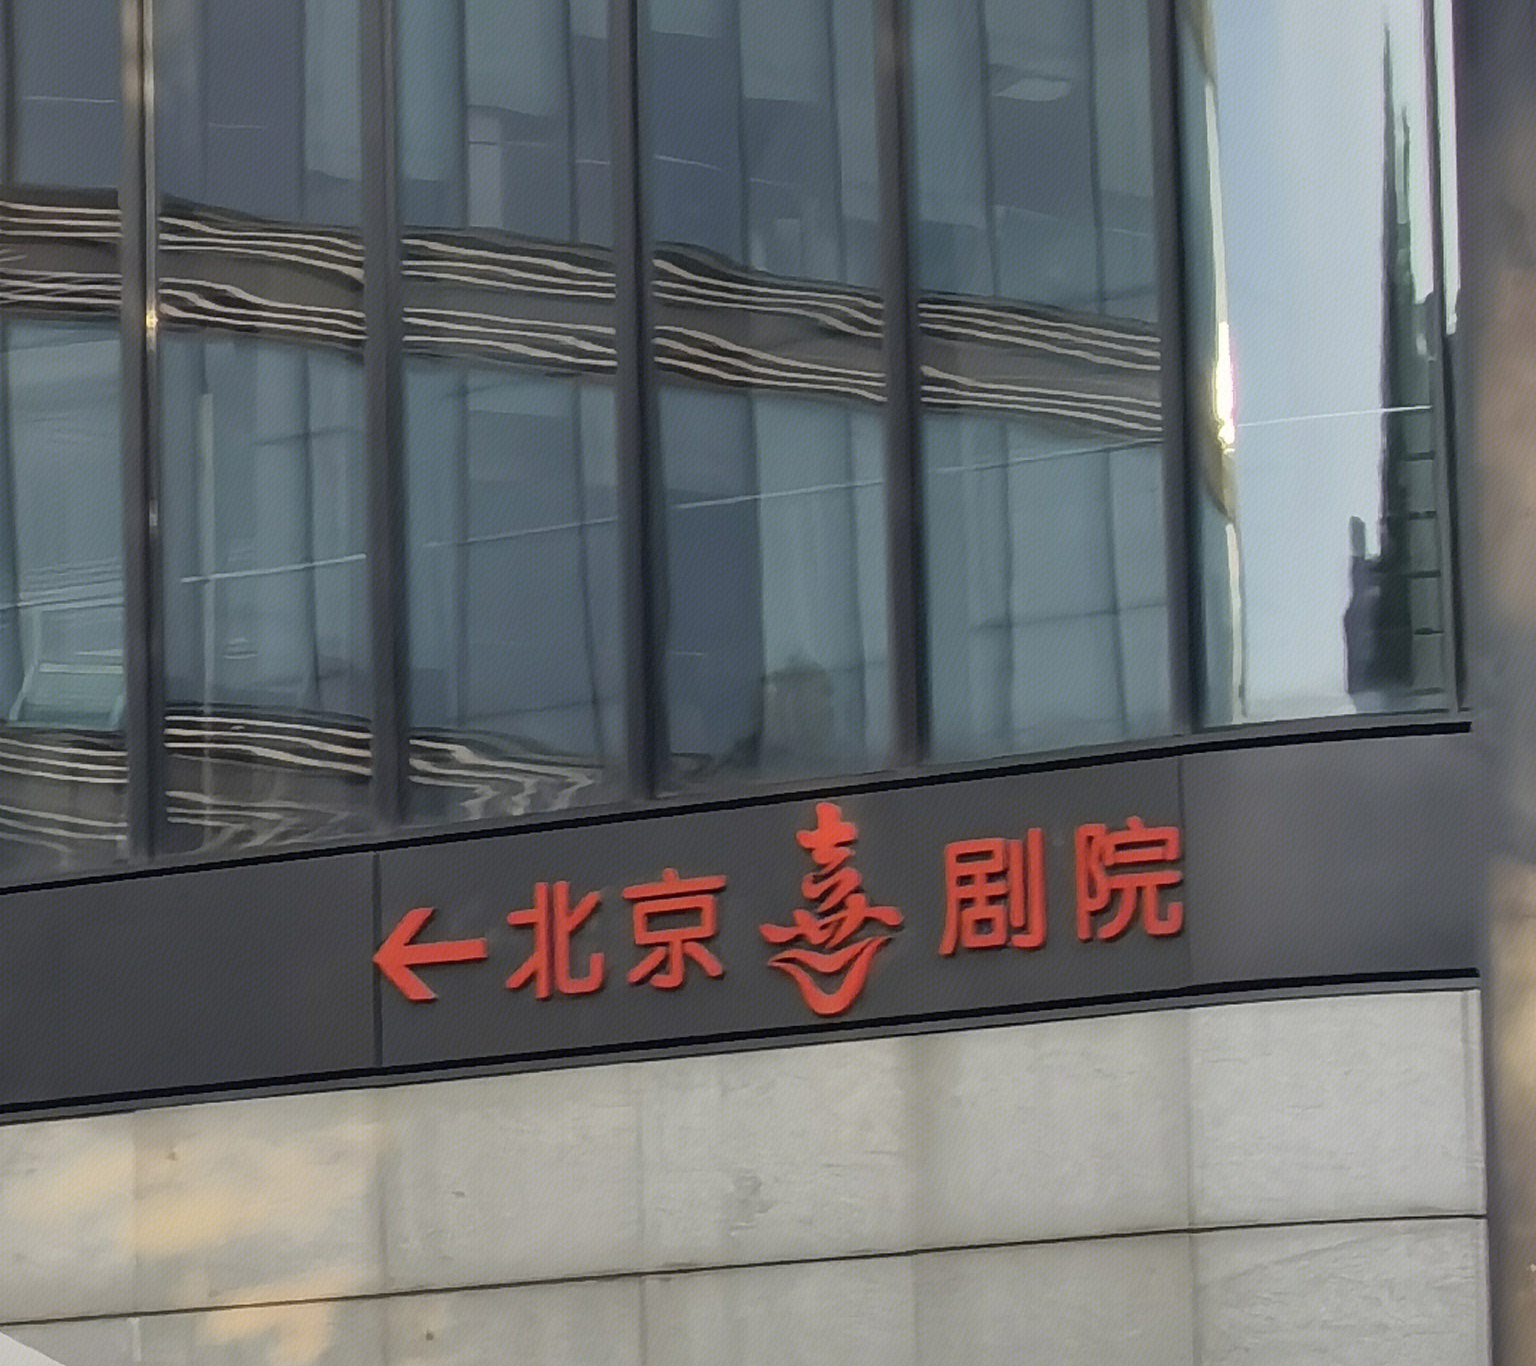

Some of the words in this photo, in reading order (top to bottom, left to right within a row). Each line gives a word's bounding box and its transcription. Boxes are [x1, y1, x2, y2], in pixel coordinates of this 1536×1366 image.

[505, 802, 1183, 1016] 北京喜剧院
